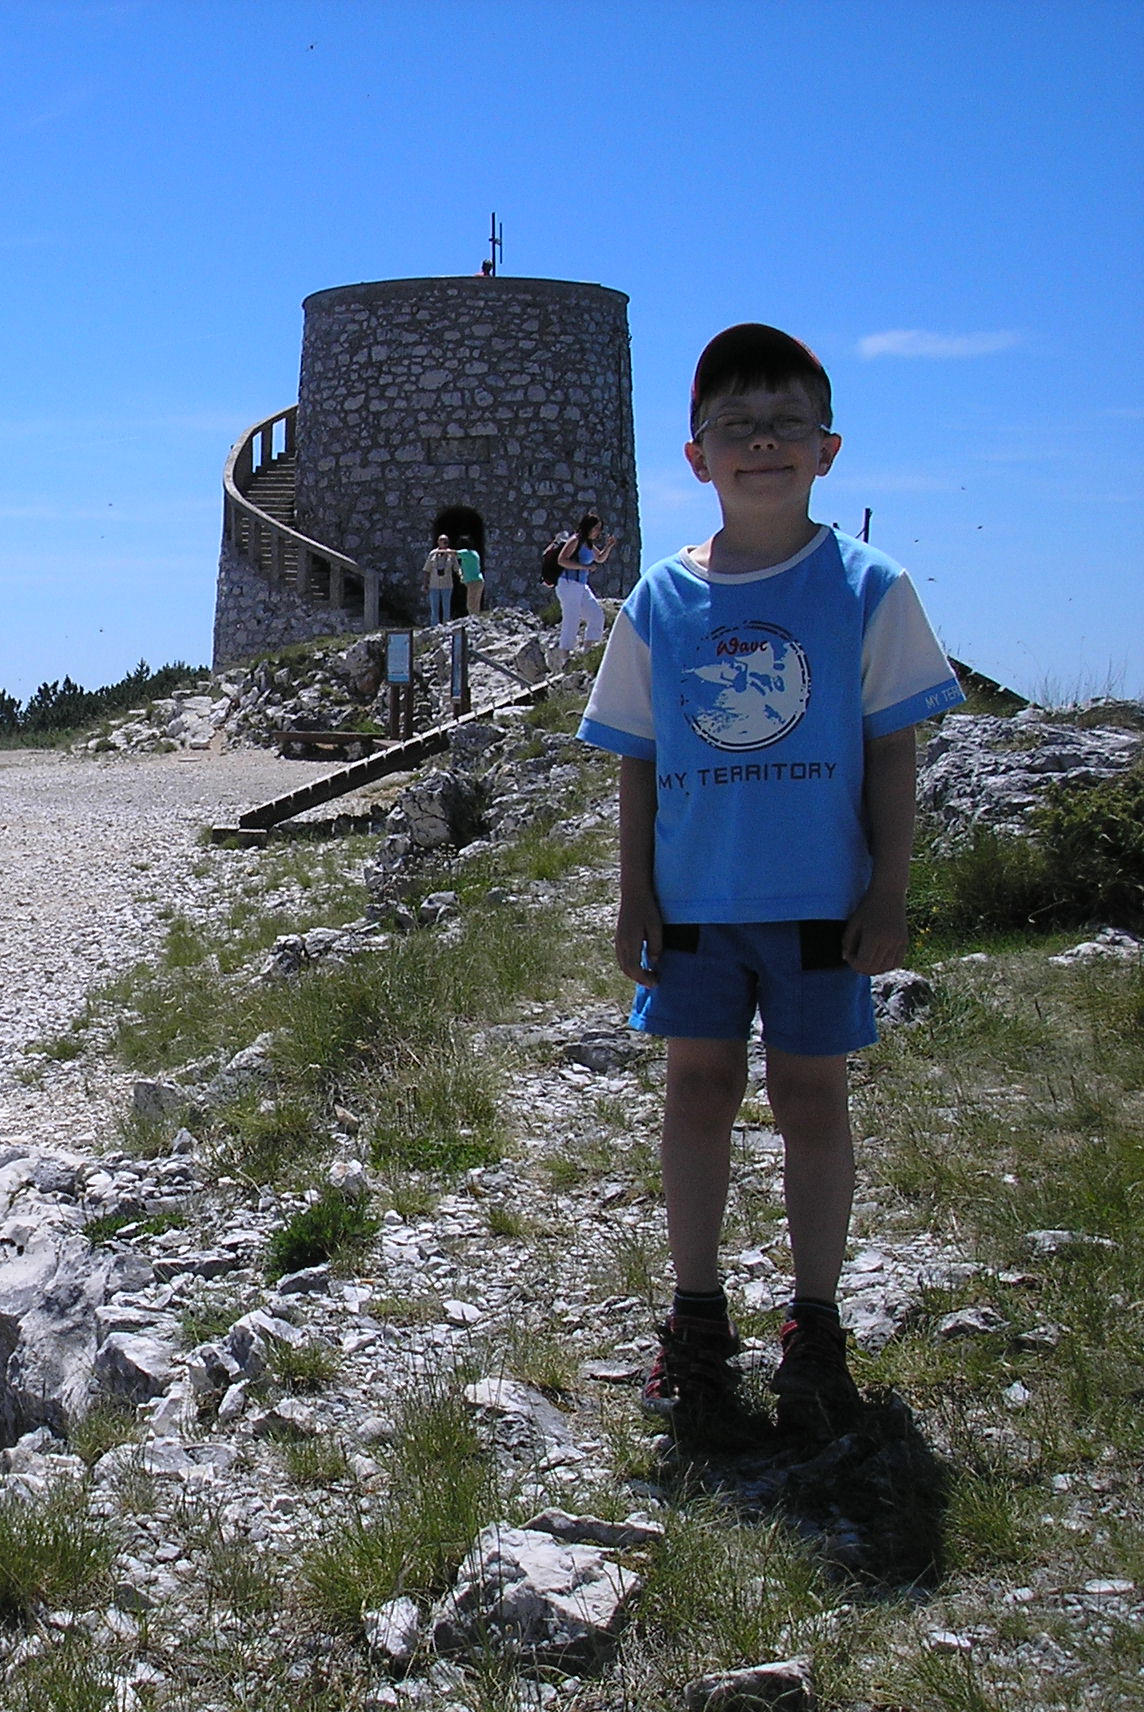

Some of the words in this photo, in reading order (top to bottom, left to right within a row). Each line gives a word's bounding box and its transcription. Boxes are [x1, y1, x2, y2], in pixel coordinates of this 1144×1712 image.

[925, 693, 940, 709] MY
[658, 772, 687, 790] MY
[697, 762, 837, 786] TERRITORY
